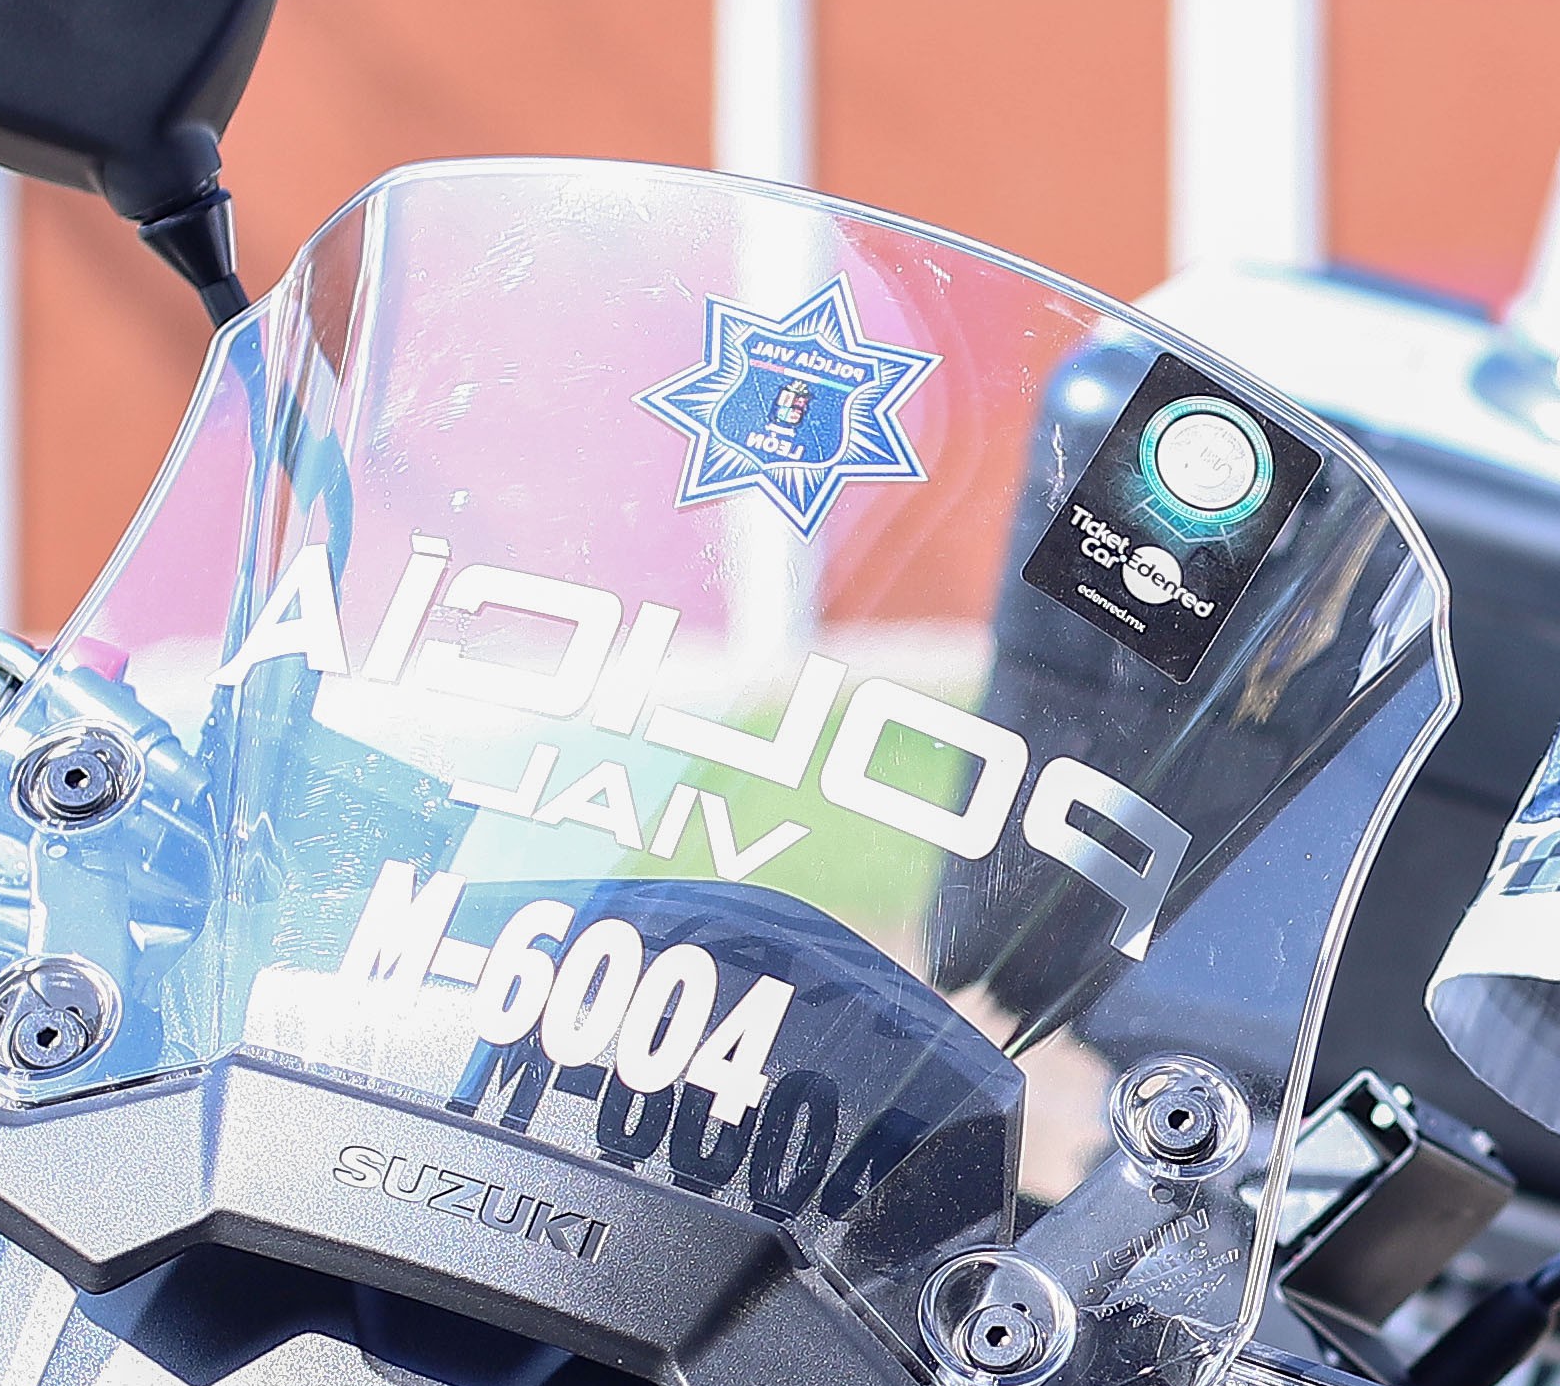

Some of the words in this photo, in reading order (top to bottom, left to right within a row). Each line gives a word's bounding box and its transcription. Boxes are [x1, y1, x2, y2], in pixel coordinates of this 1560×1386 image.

[1070, 504, 1130, 555] Ticket
[1080, 536, 1120, 569] Car
[1076, 584, 1147, 634] edenred.mx
[1126, 551, 1215, 618] Edenred
[336, 858, 795, 1126] M-6004
[333, 1145, 610, 1264] SUZUKI
